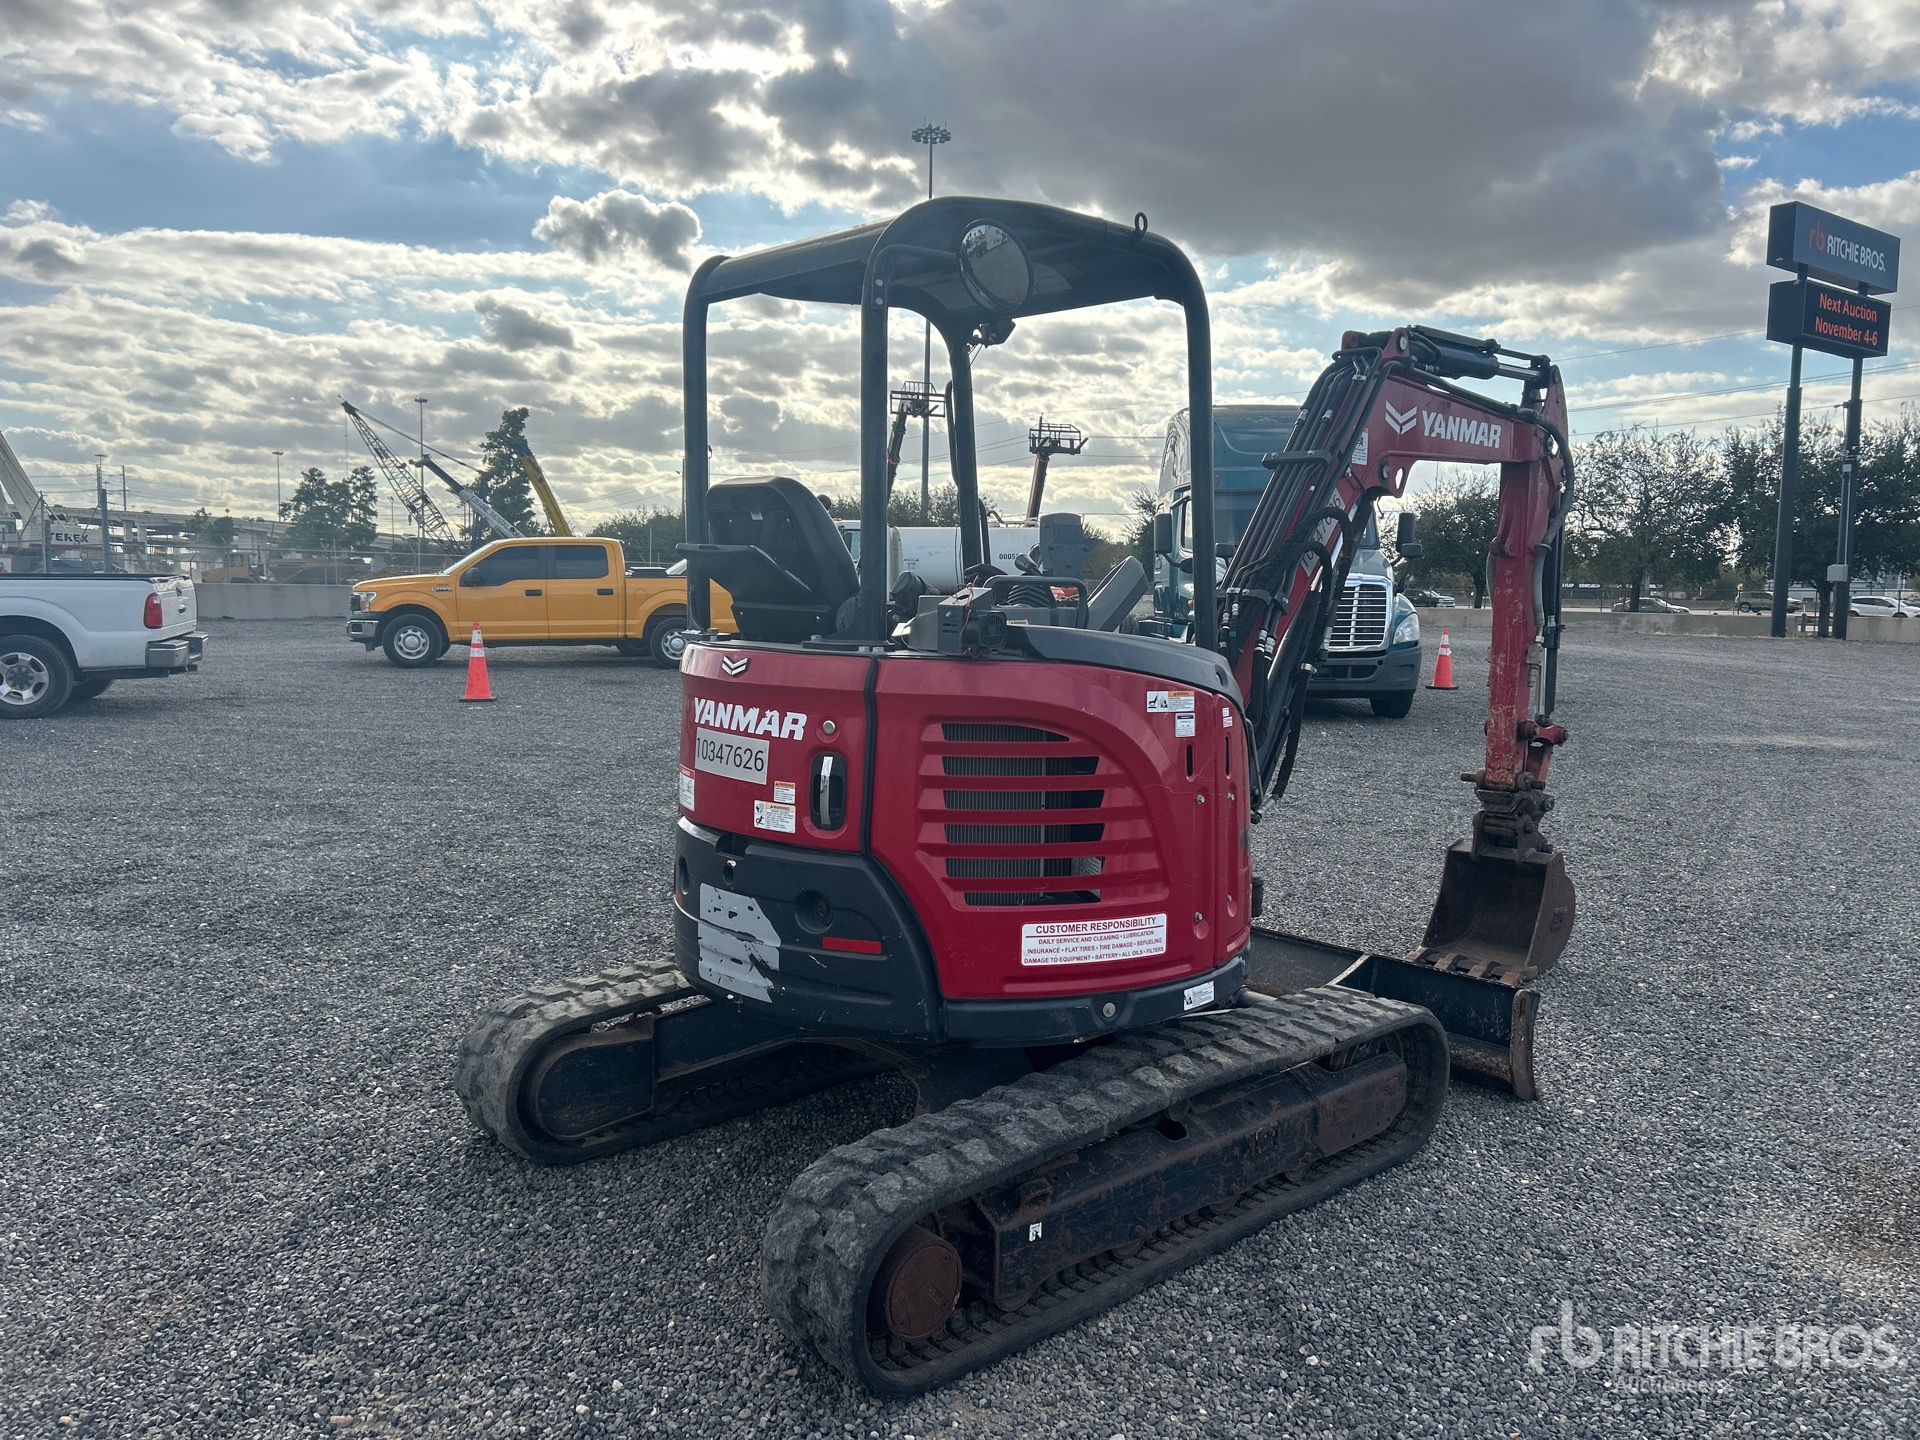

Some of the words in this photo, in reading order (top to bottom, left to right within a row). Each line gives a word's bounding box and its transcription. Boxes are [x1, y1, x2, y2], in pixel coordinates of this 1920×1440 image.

[1827, 234, 1859, 263] RITCHIE
[1860, 246, 1886, 272] BROS.
[1819, 293, 1842, 313] Next
[1843, 300, 1877, 322] Auction
[1815, 316, 1862, 341] November
[1863, 329, 1878, 346] 4-6
[1422, 410, 1502, 449] YANMAR
[50, 532, 89, 543] TEREX
[693, 697, 808, 741] YANMAR
[696, 737, 765, 772] 10347626
[1035, 924, 1088, 934] CUSTOMER
[1090, 917, 1157, 931] RESPONSIBILITY
[1093, 934, 1119, 942] CLEANING
[1123, 930, 1154, 939] LUBRICATION
[1136, 938, 1162, 946] REFUELING
[1146, 946, 1164, 954] FILTERS
